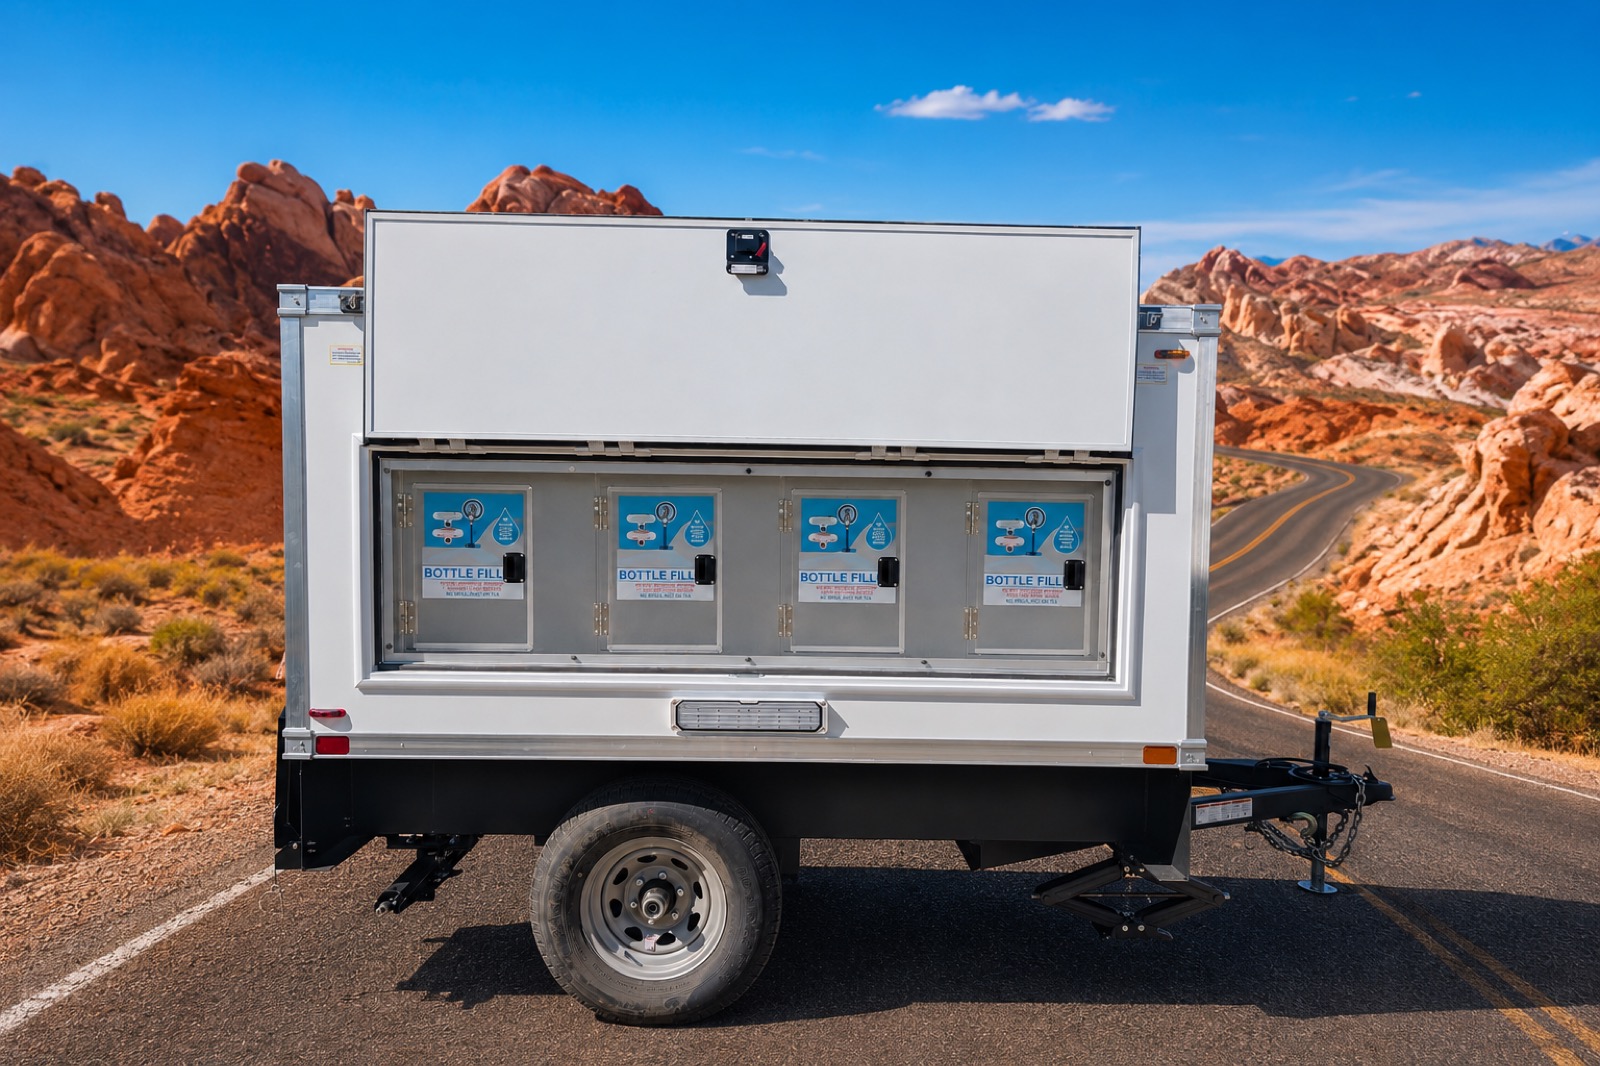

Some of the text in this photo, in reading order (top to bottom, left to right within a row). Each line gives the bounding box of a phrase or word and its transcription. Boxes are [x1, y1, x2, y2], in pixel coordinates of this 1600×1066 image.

[424, 567, 503, 579] BOTTLE FILL
[619, 569, 696, 581] BOTTLE FILL
[800, 572, 877, 583] BOTTLE FILL
[985, 575, 1062, 587] BOTTLE FILL
